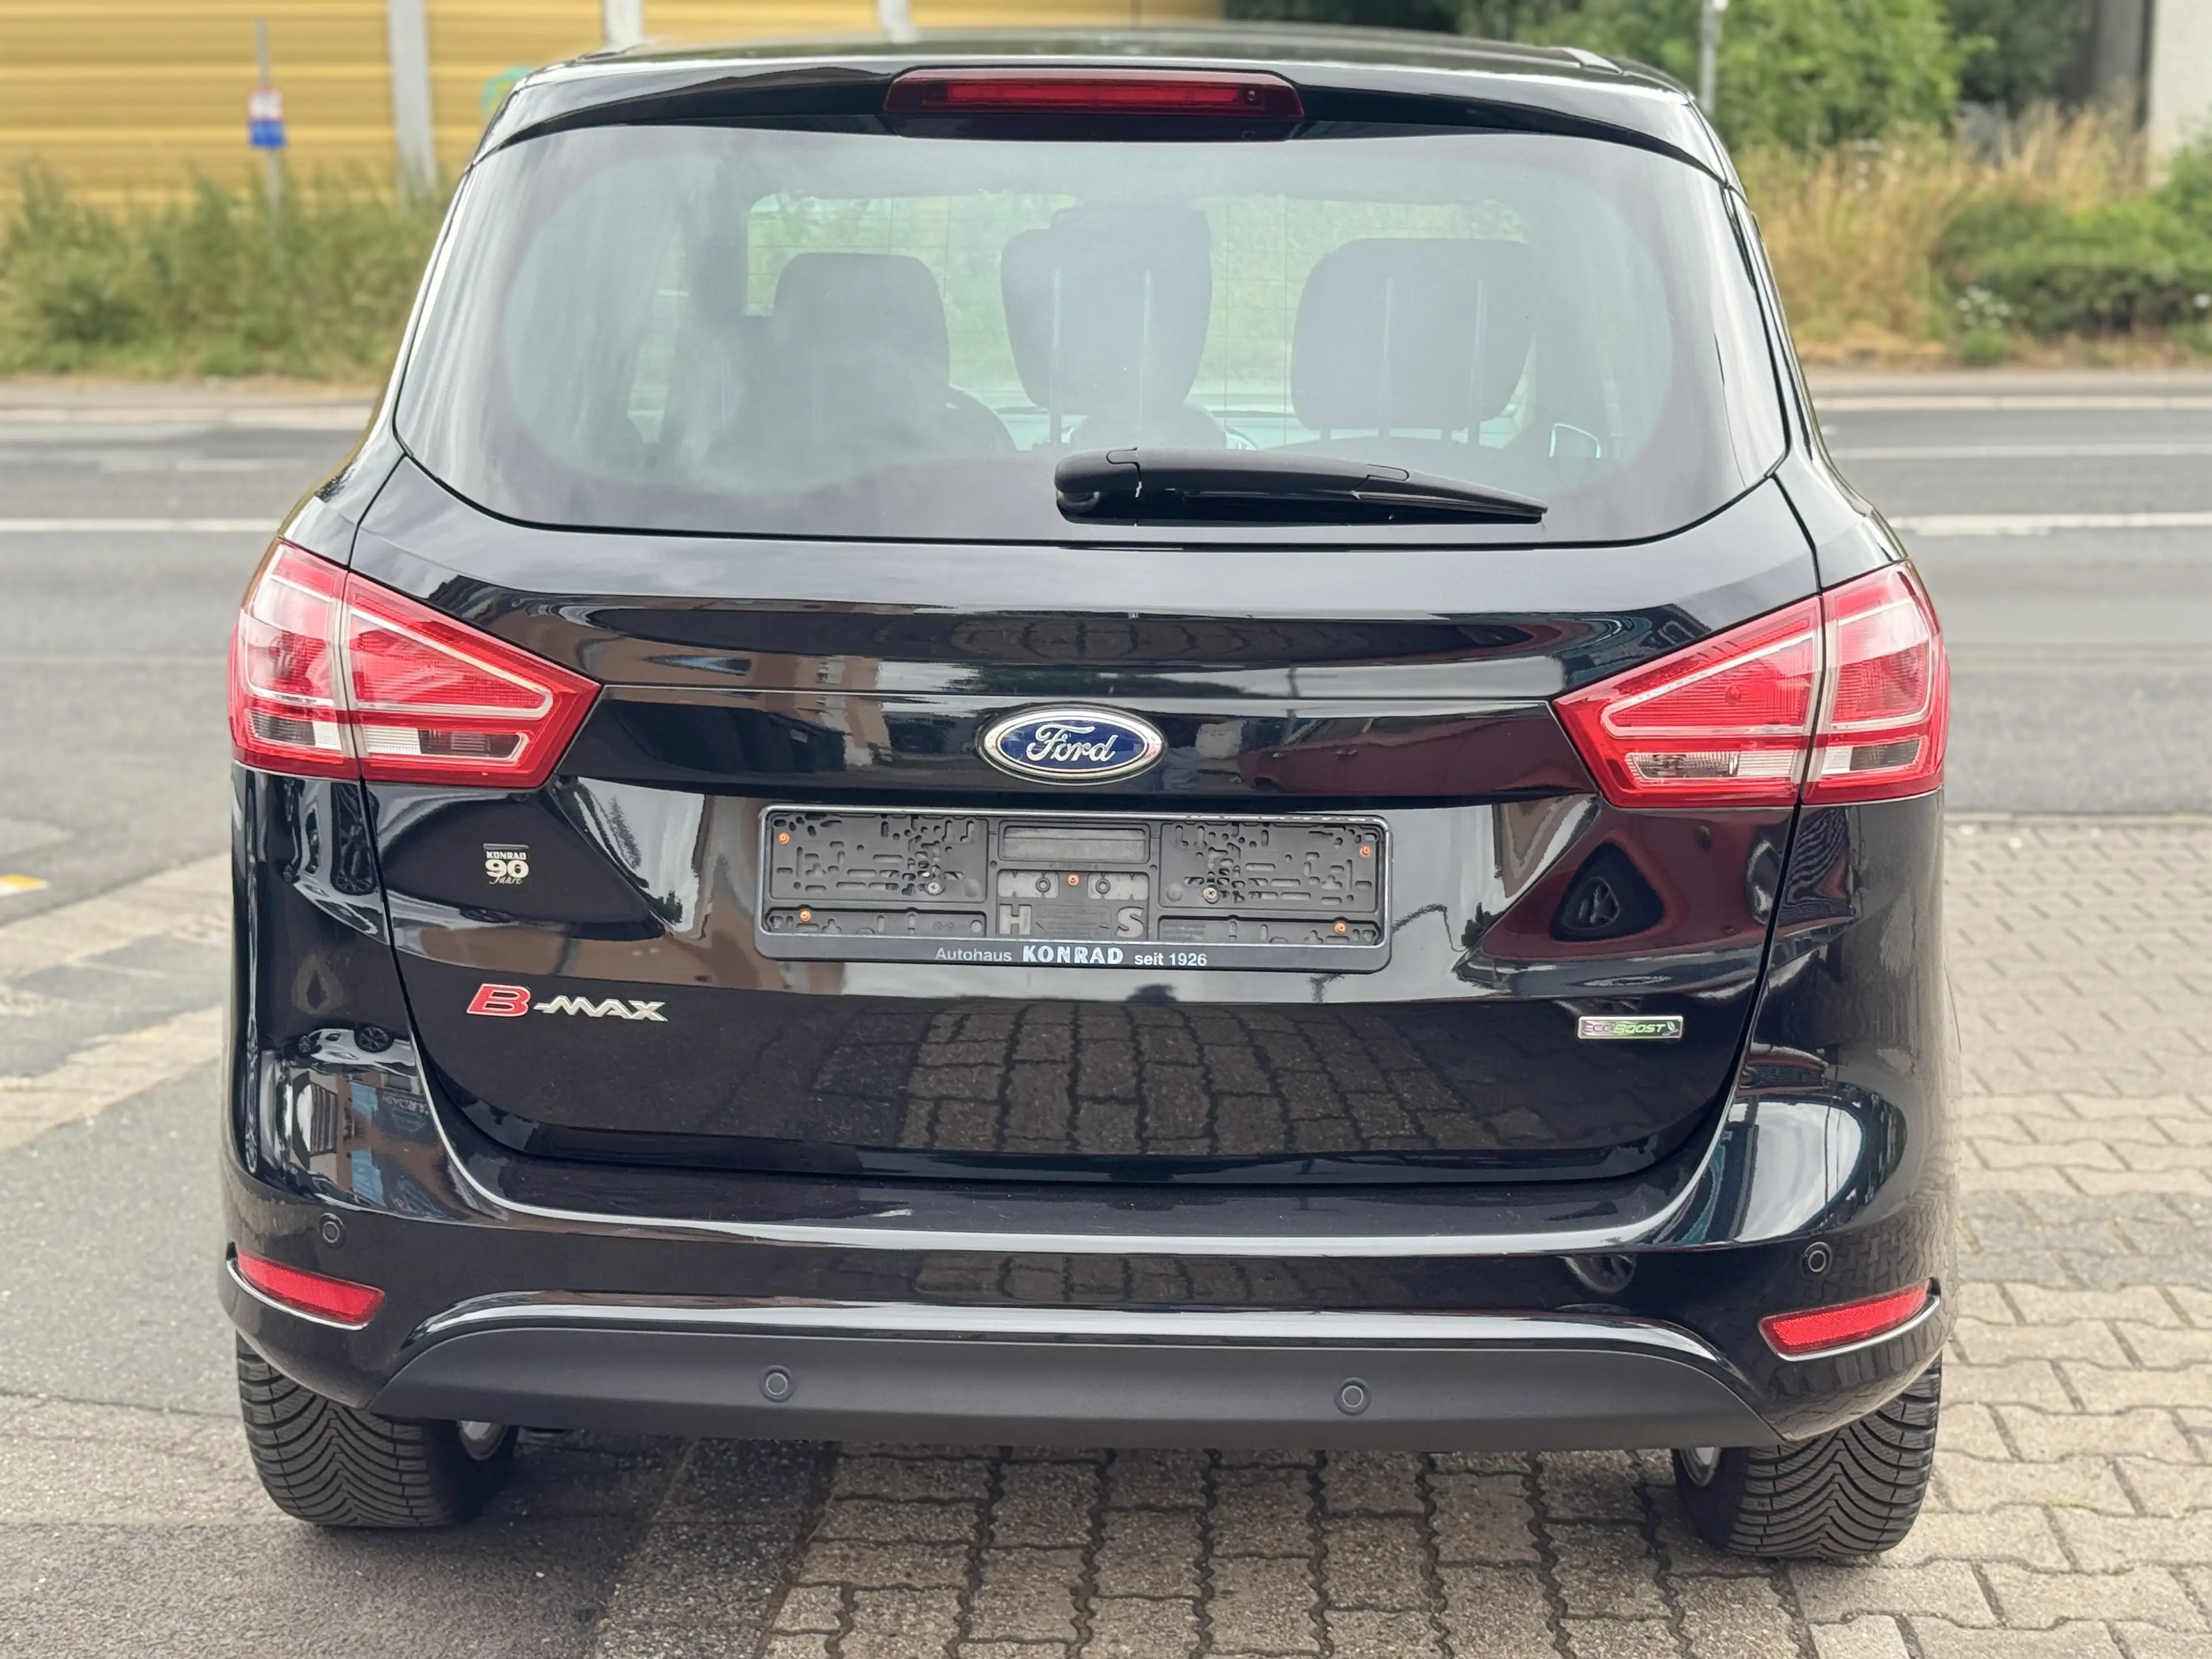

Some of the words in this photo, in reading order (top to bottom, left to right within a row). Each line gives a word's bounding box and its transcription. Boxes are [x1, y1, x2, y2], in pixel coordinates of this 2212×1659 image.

[1026, 724, 1119, 762] Ford
[486, 851, 527, 860] KONRAD
[485, 859, 529, 878] 90
[935, 946, 1012, 963] Autohaus
[1022, 945, 1124, 964] KONRAD
[1134, 952, 1164, 966] seit
[1169, 952, 1207, 967] 1926
[466, 983, 669, 1022] B-MAX
